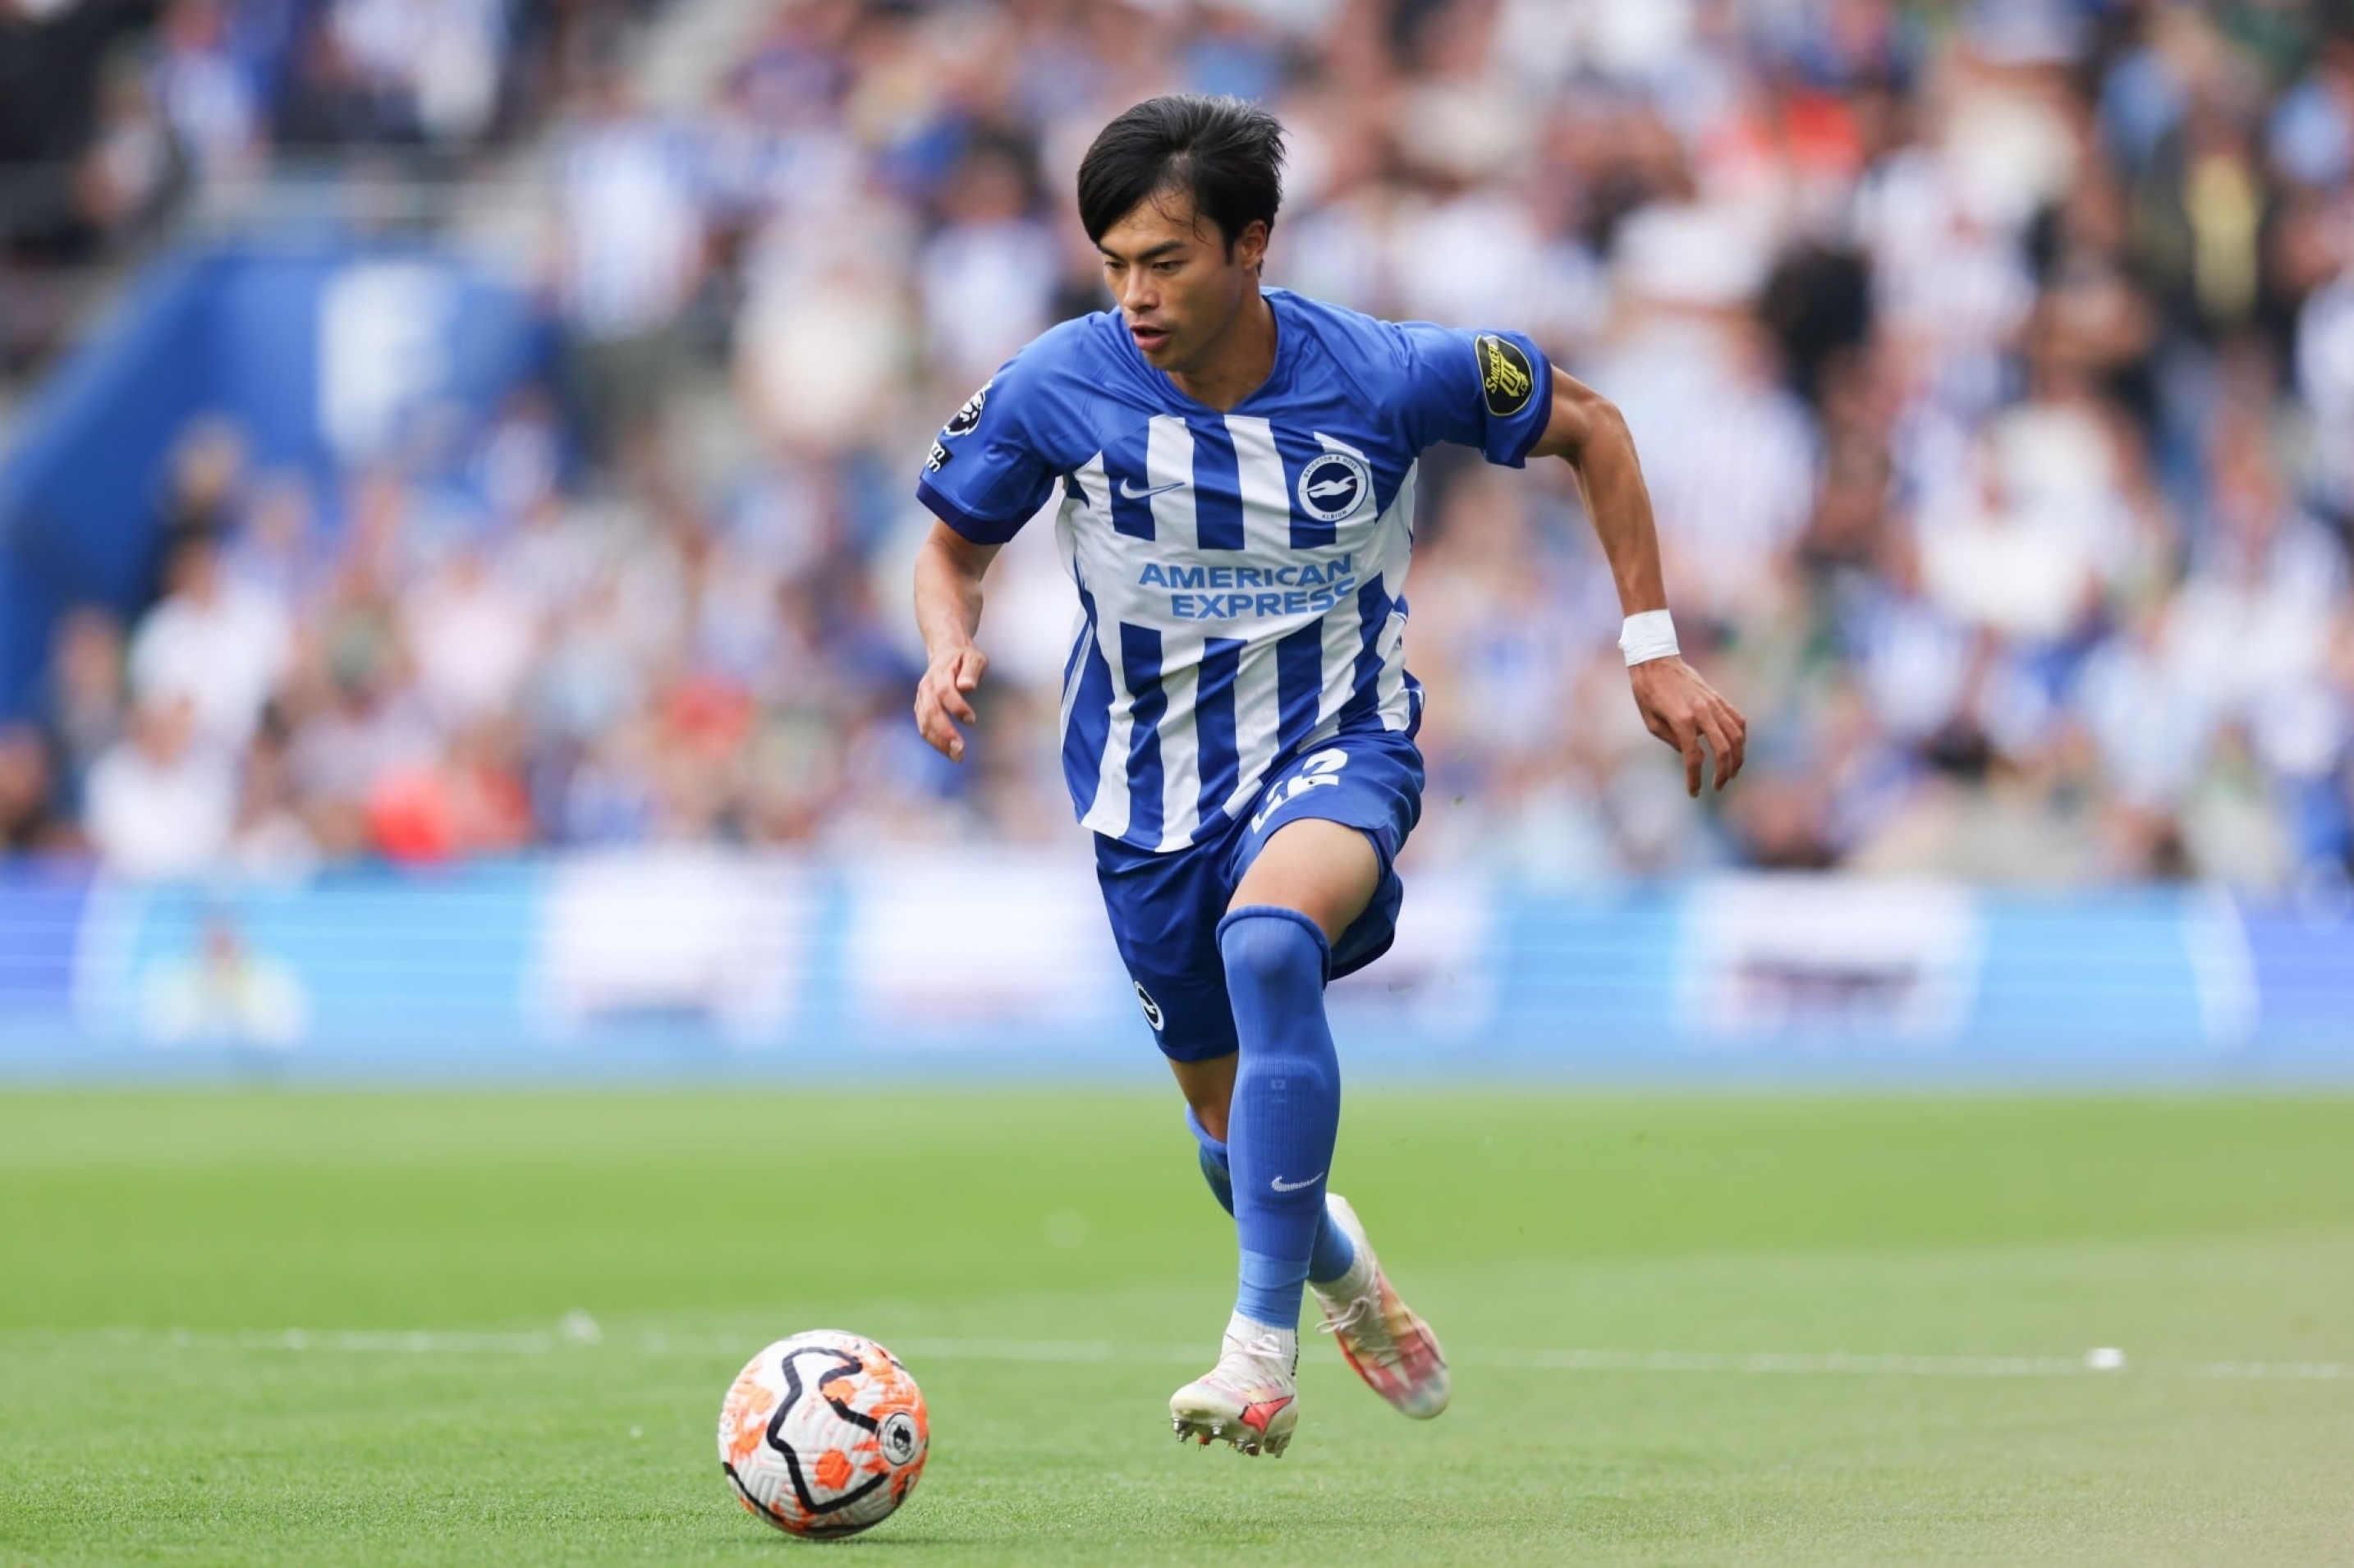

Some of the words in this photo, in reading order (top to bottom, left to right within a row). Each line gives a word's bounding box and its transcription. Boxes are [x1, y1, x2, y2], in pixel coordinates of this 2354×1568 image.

[1321, 510, 1347, 519] ALBION
[1138, 553, 1352, 589] AMERICAN
[1171, 577, 1356, 619] EXPRESS
